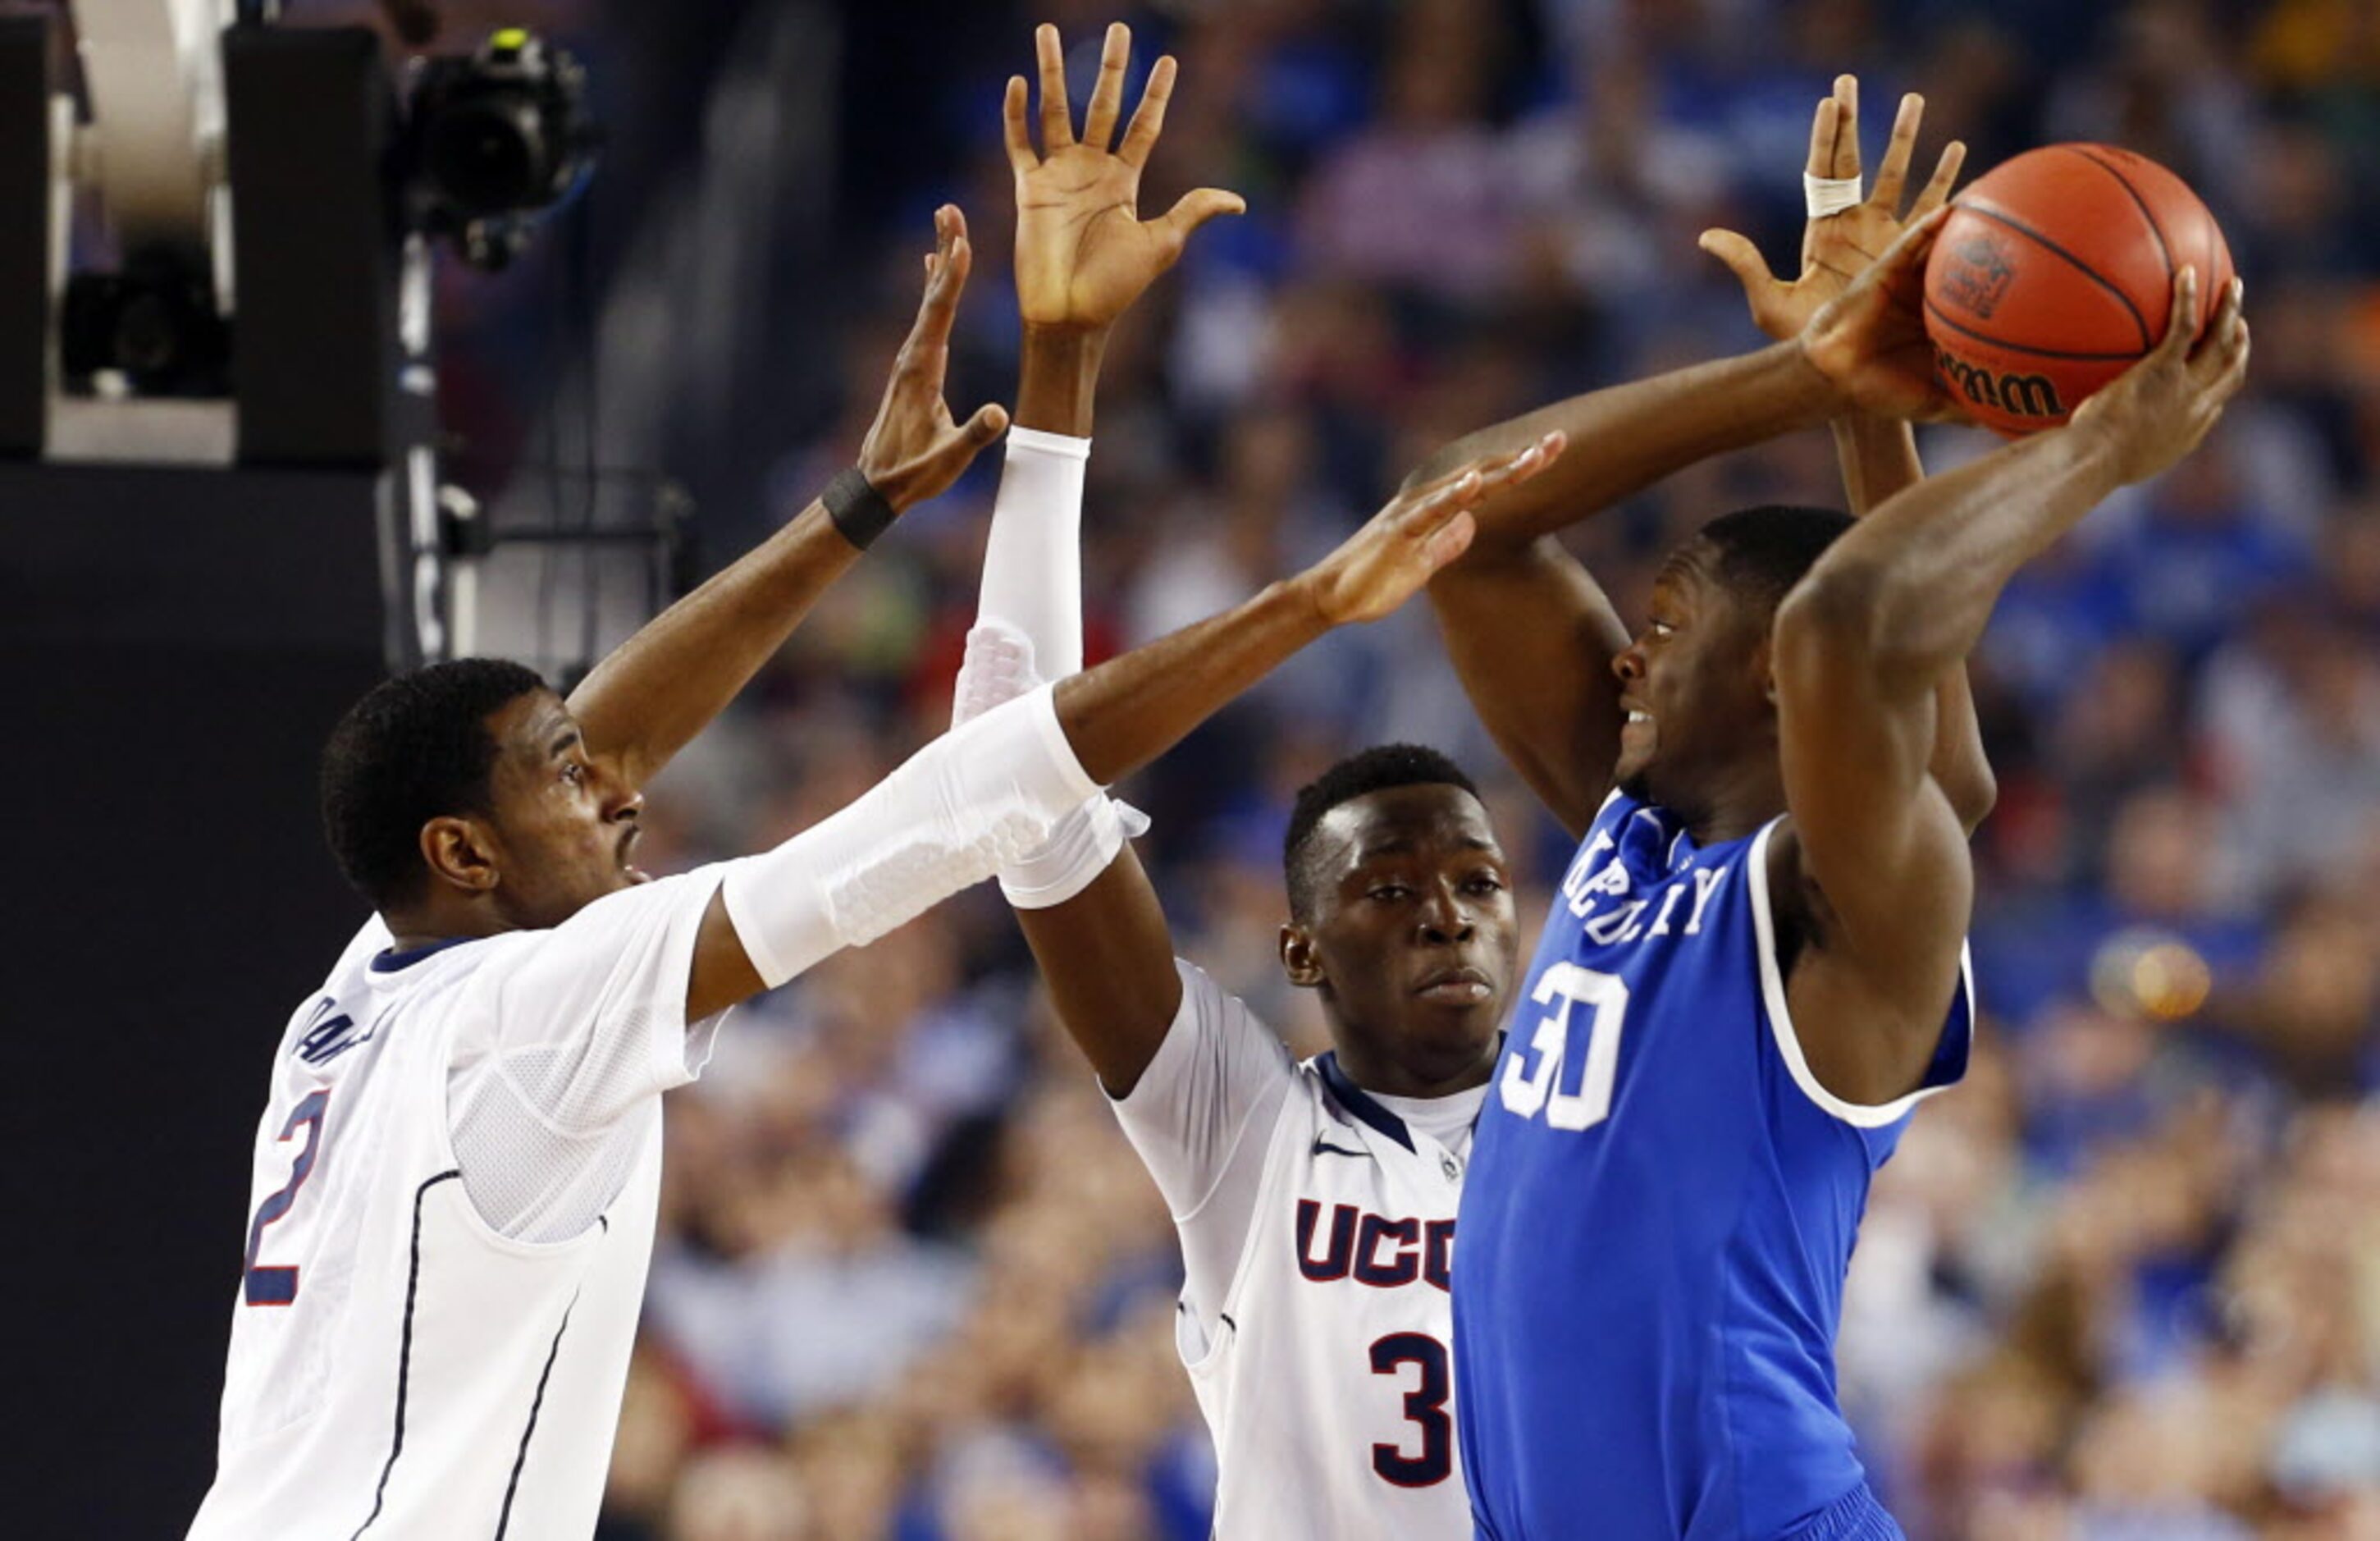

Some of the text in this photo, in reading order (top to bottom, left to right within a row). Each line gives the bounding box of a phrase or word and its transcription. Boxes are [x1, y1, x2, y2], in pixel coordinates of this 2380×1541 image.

[1500, 959, 1630, 1132] 30
[244, 1087, 332, 1307] 2
[1368, 1331, 1451, 1488] 3
